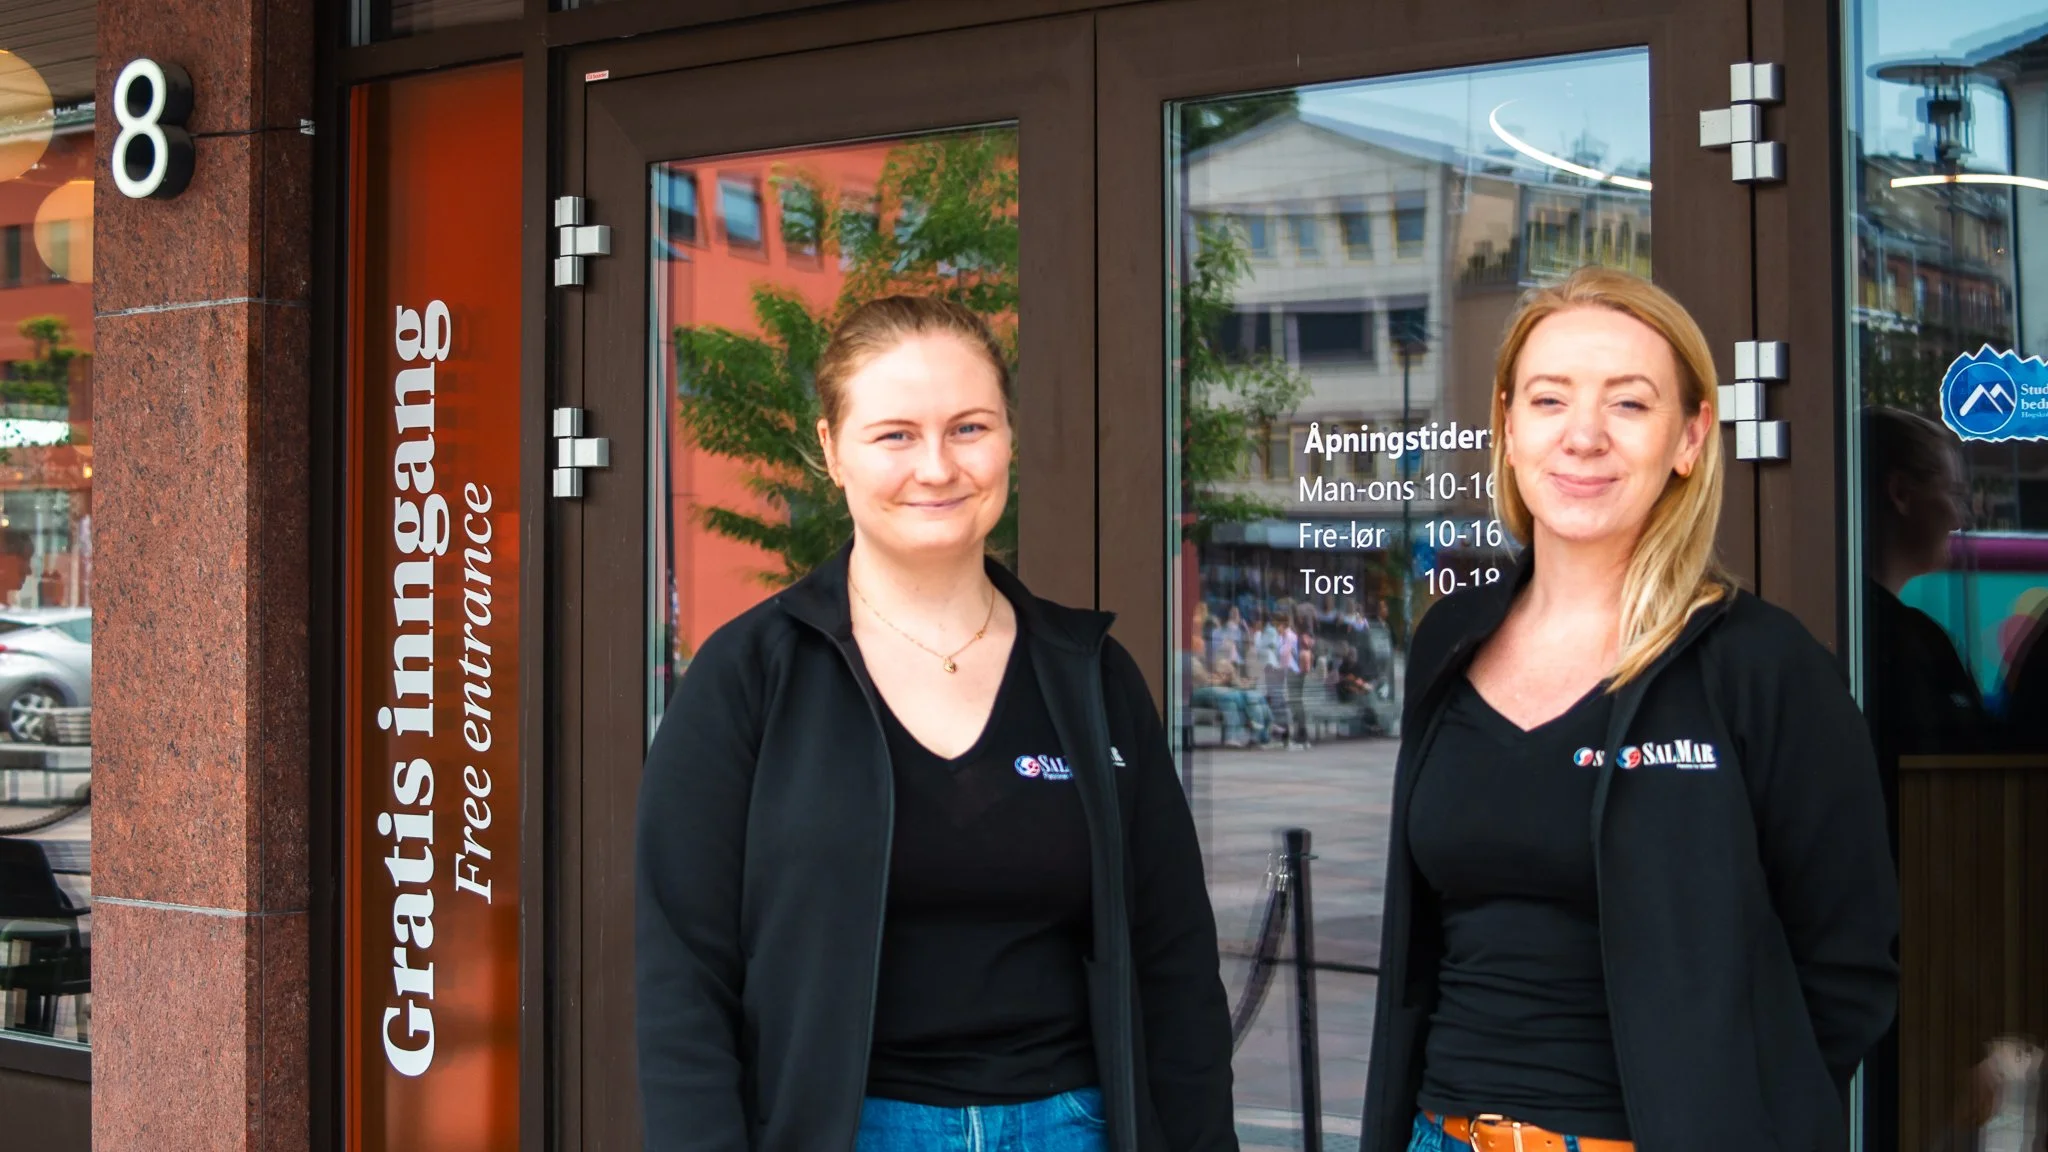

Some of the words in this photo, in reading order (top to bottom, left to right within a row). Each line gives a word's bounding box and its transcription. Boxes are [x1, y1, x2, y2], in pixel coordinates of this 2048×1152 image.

[112, 58, 168, 199] 8
[1304, 421, 1493, 461] Åpningstider:
[376, 299, 452, 738] inngang
[1299, 475, 1415, 502] Man-ons
[1299, 520, 1385, 549] Fre-lør
[1424, 519, 1503, 548] 10-16
[455, 481, 495, 753] entrance
[1300, 568, 1354, 595] Tors
[1037, 754, 1070, 773] SAL
[454, 766, 495, 906] Free
[376, 758, 436, 1078] Gratis
